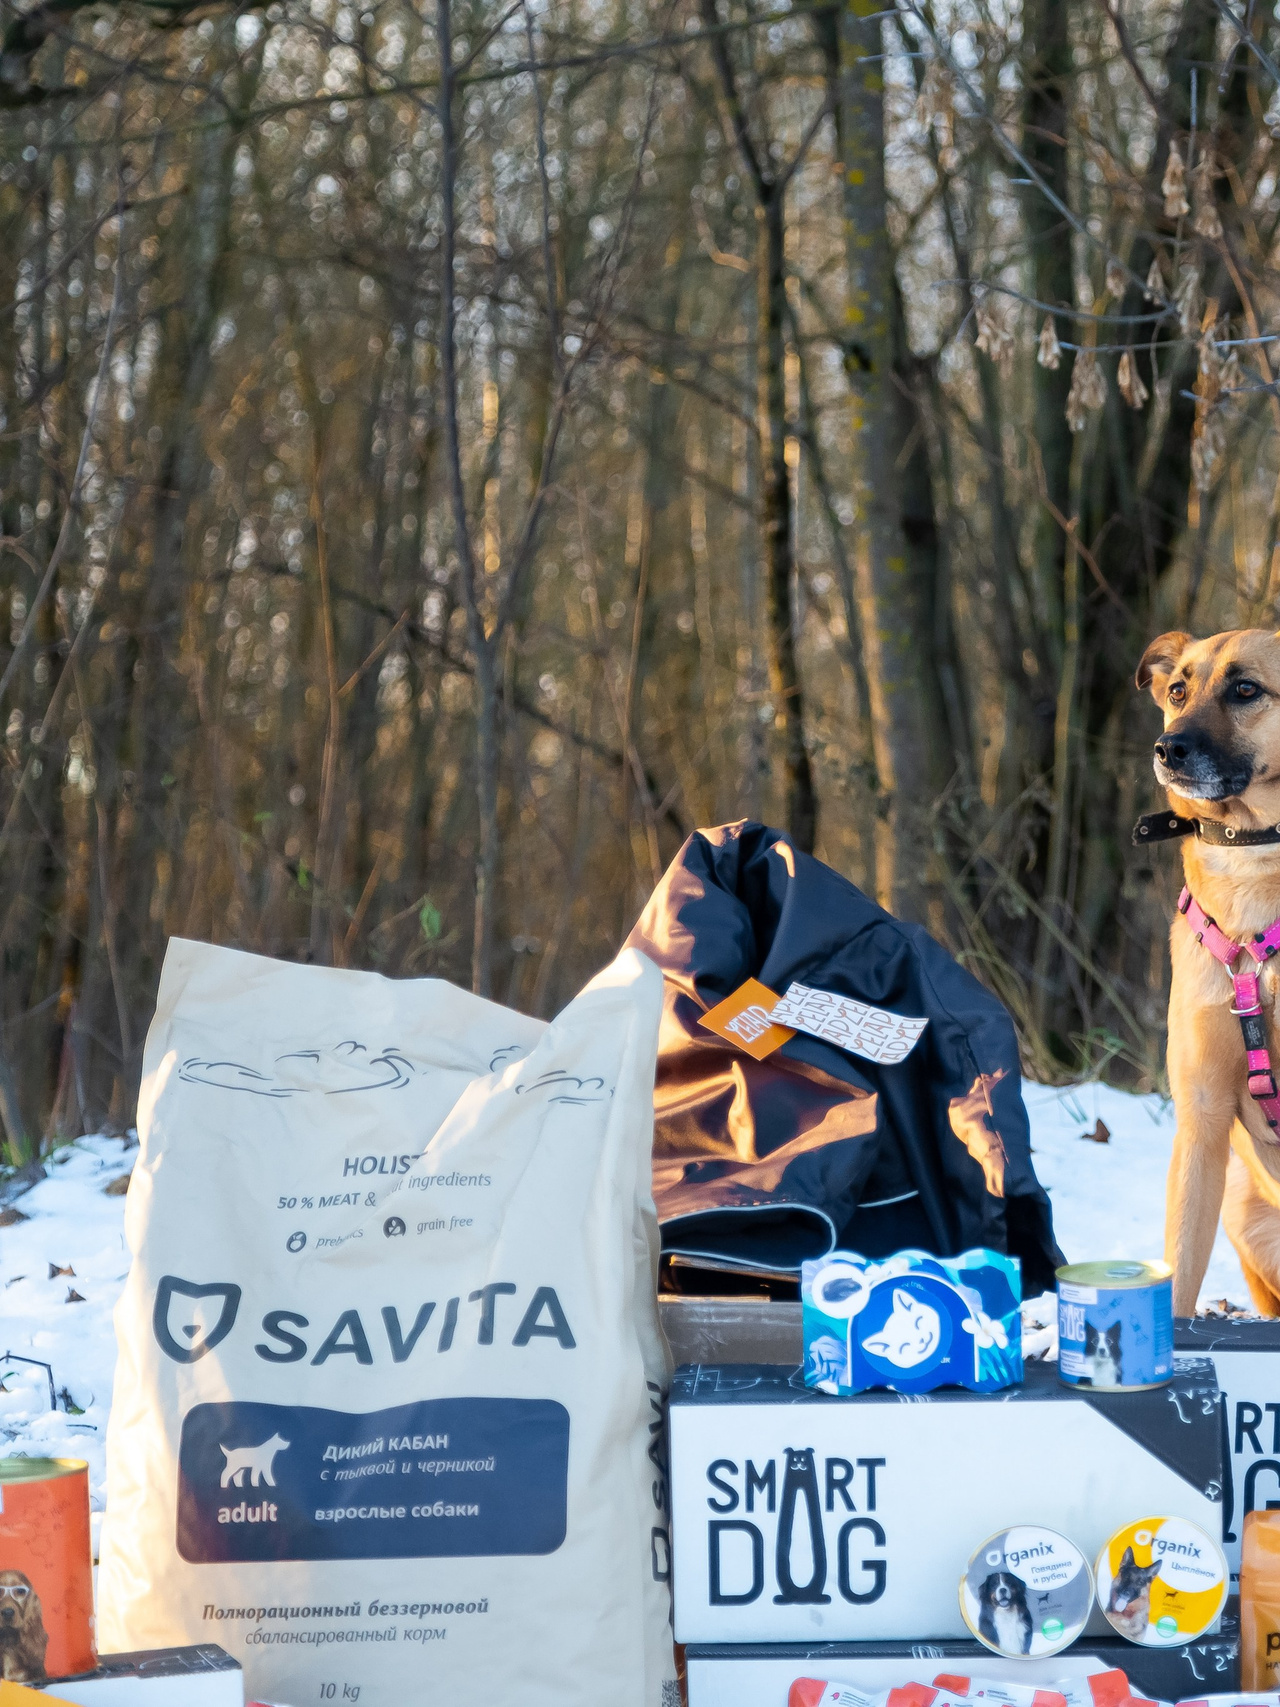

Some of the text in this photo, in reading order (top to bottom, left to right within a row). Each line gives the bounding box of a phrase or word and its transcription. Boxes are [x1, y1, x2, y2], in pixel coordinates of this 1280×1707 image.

[277, 1196, 297, 1210] 50
[300, 1197, 314, 1209] %
[318, 1192, 361, 1209] MEAT
[364, 1191, 377, 1207] &
[408, 1172, 492, 1191] ingredients
[416, 1219, 446, 1235] grain
[449, 1216, 473, 1232] free
[254, 1282, 577, 1366] SAVITA
[388, 1434, 448, 1451] КАБАН
[335, 1460, 395, 1481] тыквой
[401, 1463, 411, 1474] и
[418, 1456, 495, 1476] черникой
[706, 1447, 886, 1512] SMART
[218, 1502, 278, 1523] adult
[315, 1501, 479, 1523] взрослые собаки
[708, 1517, 887, 1606] DOG
[1031, 1560, 1072, 1575] Говядина
[1171, 1561, 1216, 1580] Цыплёнок
[1041, 1572, 1068, 1585] рубец
[202, 1599, 489, 1622] Полнорационный беззерновой
[245, 1627, 447, 1647] сбалансированный корм
[319, 1682, 361, 1702] 10 kg
